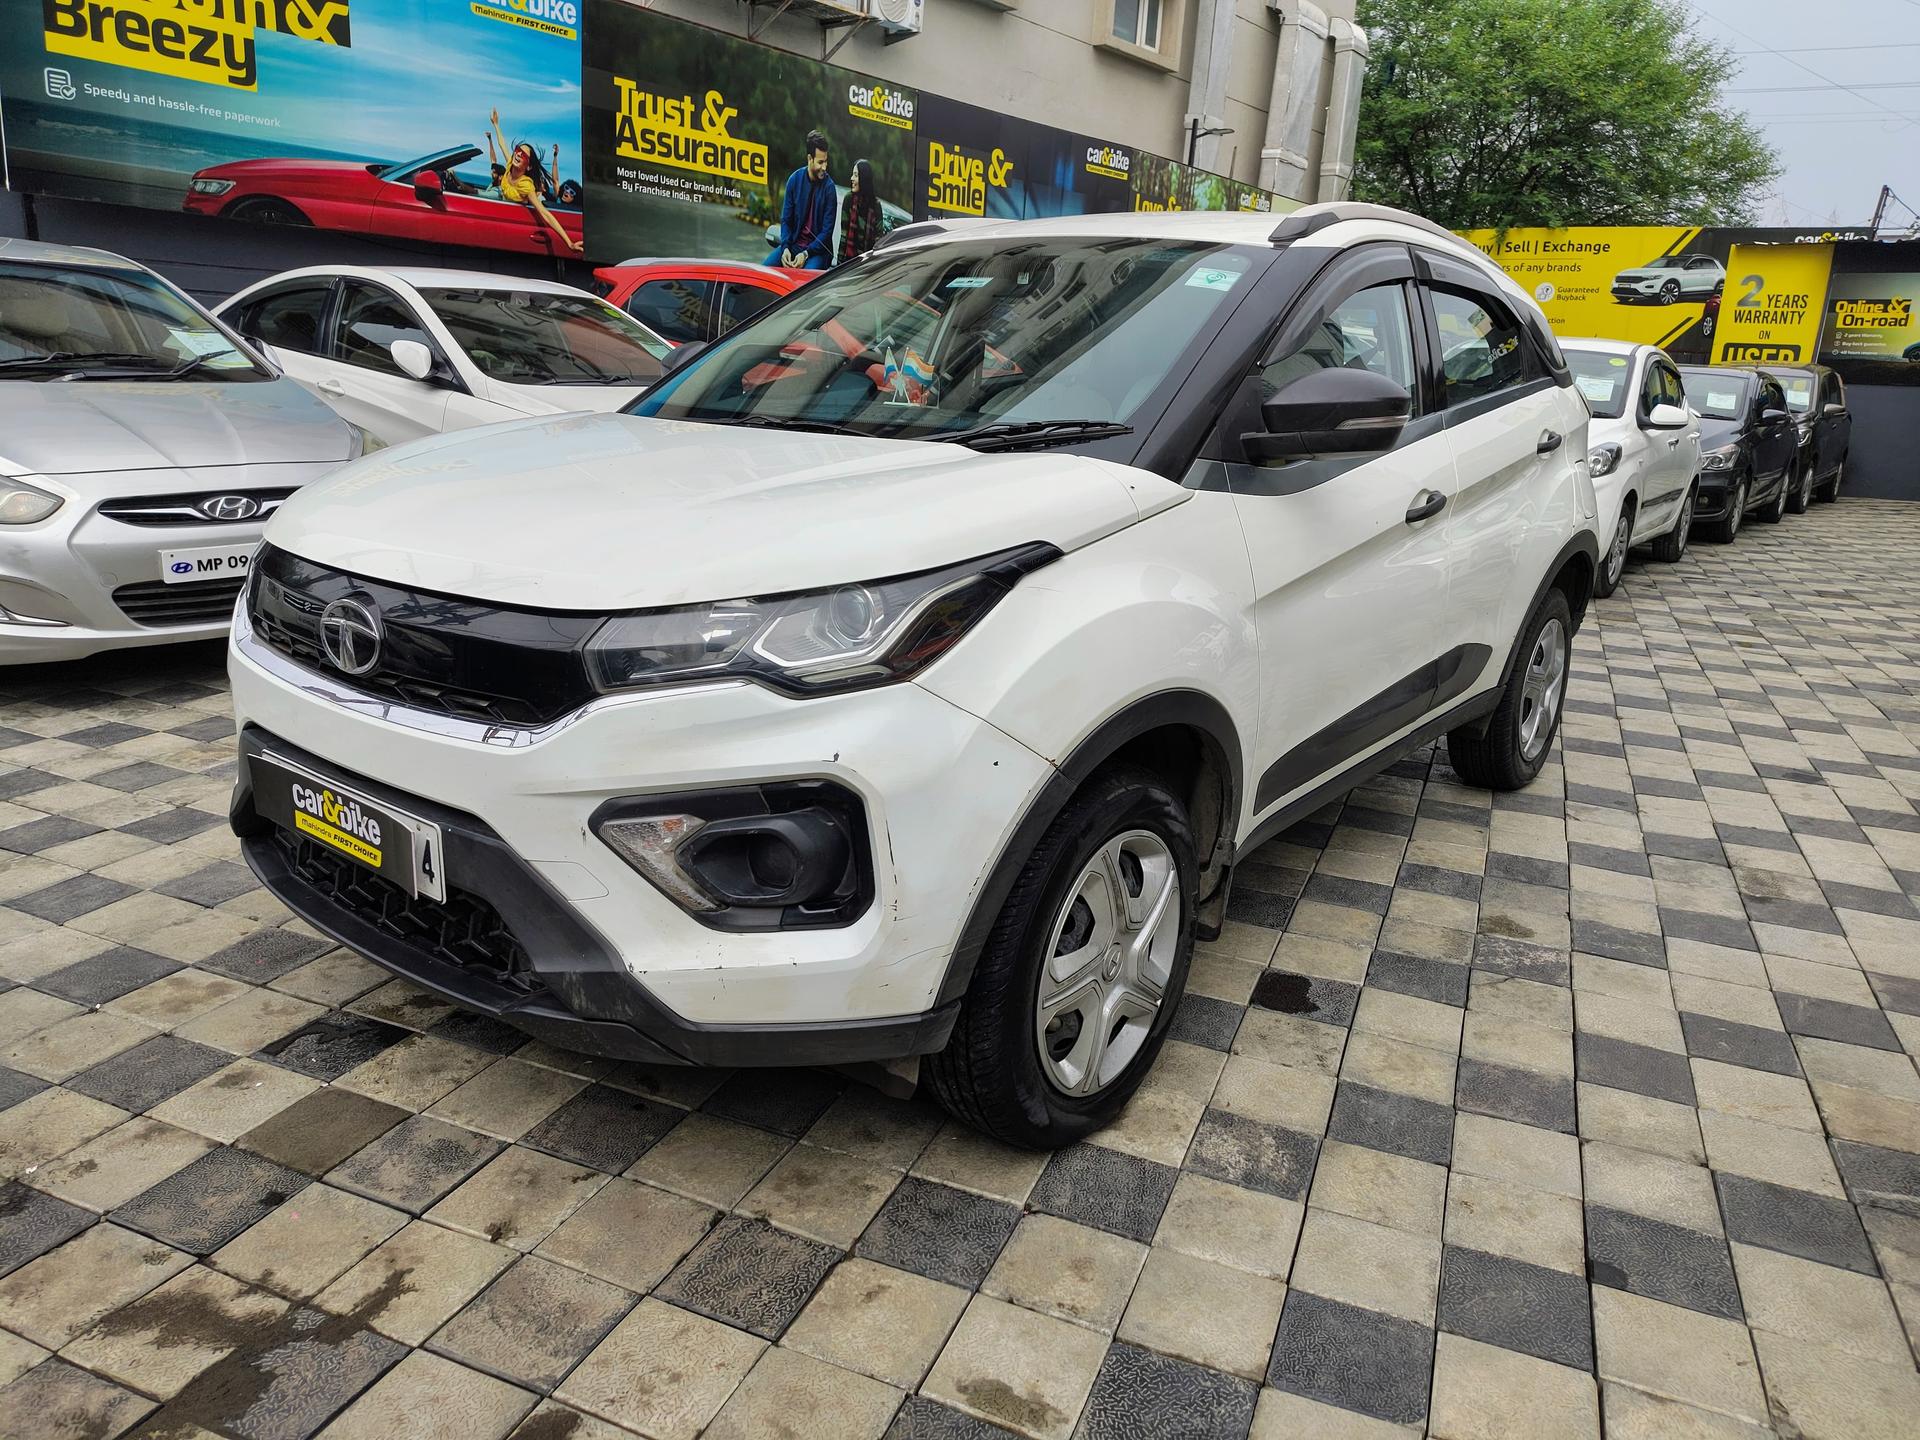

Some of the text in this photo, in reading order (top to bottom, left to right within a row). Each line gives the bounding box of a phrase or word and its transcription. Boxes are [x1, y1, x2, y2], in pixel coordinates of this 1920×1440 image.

[516, 17, 539, 28] FIRST
[540, 23, 568, 36] CHOICE
[46, 0, 256, 86] Breezy
[84, 83, 281, 129] Speedy and hassle-free paperwork
[613, 76, 738, 138] Trust &
[849, 85, 913, 118] car&bike
[616, 115, 765, 177] Assurance
[1087, 146, 1130, 170] car&bike
[929, 142, 1014, 188] Drive &
[617, 167, 741, 198] Most loved Used Car brand of India
[622, 181, 633, 192] By
[634, 183, 671, 197] Franchise
[672, 189, 692, 202] India,
[693, 194, 703, 203] ET
[929, 173, 982, 210] Smile
[1505, 241, 1530, 252] Sell
[1543, 241, 1611, 254] Exchange
[1514, 262, 1525, 272] of
[1526, 265, 1544, 274] any
[1547, 262, 1582, 272] brands
[1557, 286, 1600, 294] Guaranteed
[1737, 274, 1809, 309] 2 YEARS
[1734, 309, 1806, 325] WARRANTY
[1836, 295, 1912, 316] Online &
[1842, 313, 1910, 327] On-road
[1758, 330, 1771, 340] ON
[197, 555, 249, 572] MP 09
[292, 783, 381, 845] car&bike
[333, 834, 353, 848] FIRST
[353, 843, 378, 861] CHOICE
